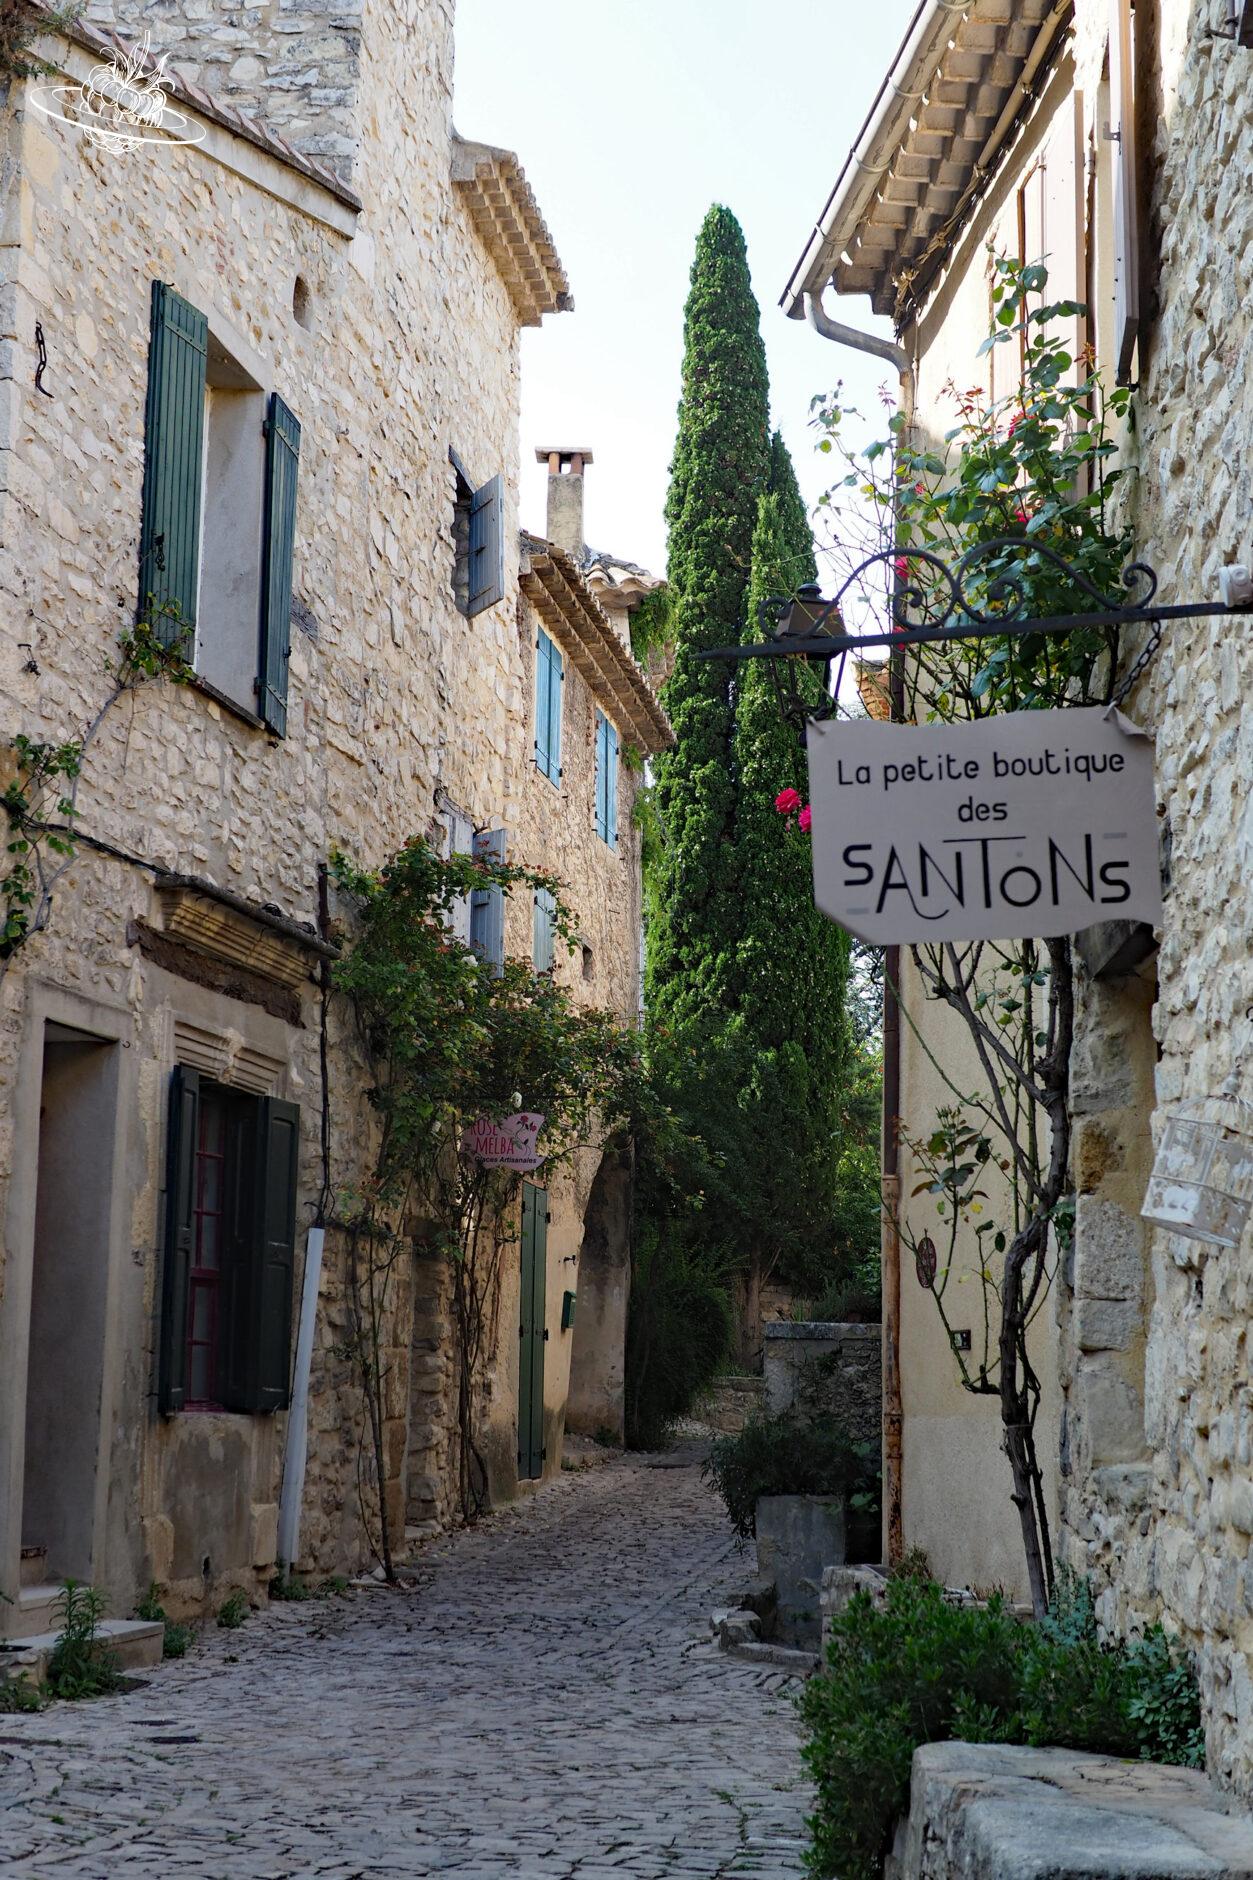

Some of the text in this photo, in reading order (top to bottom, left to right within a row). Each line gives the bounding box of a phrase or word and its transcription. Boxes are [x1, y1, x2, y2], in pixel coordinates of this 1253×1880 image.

[838, 748, 1125, 790] La petite boutique
[958, 796, 1008, 822] des
[842, 833, 1131, 919] SANTONS
[475, 1136, 514, 1155] MELBA
[499, 1156, 537, 1164] Artisanales
